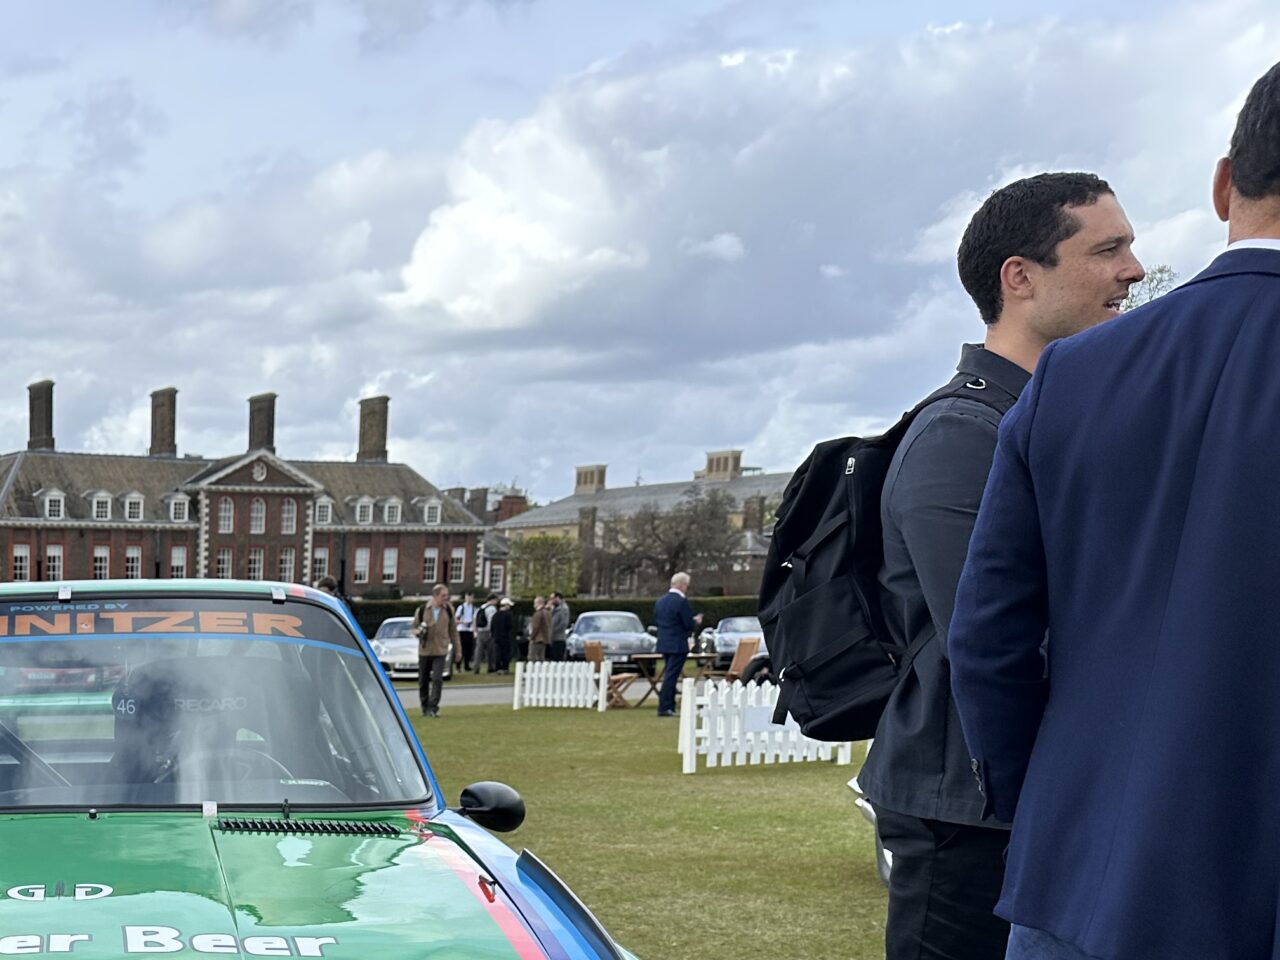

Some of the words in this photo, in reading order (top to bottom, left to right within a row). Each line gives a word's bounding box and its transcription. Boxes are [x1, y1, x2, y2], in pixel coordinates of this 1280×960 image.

[10, 604, 99, 612] POWERED
[116, 699, 136, 714] 46
[175, 697, 247, 711] RECARO
[124, 925, 338, 957] Beer
